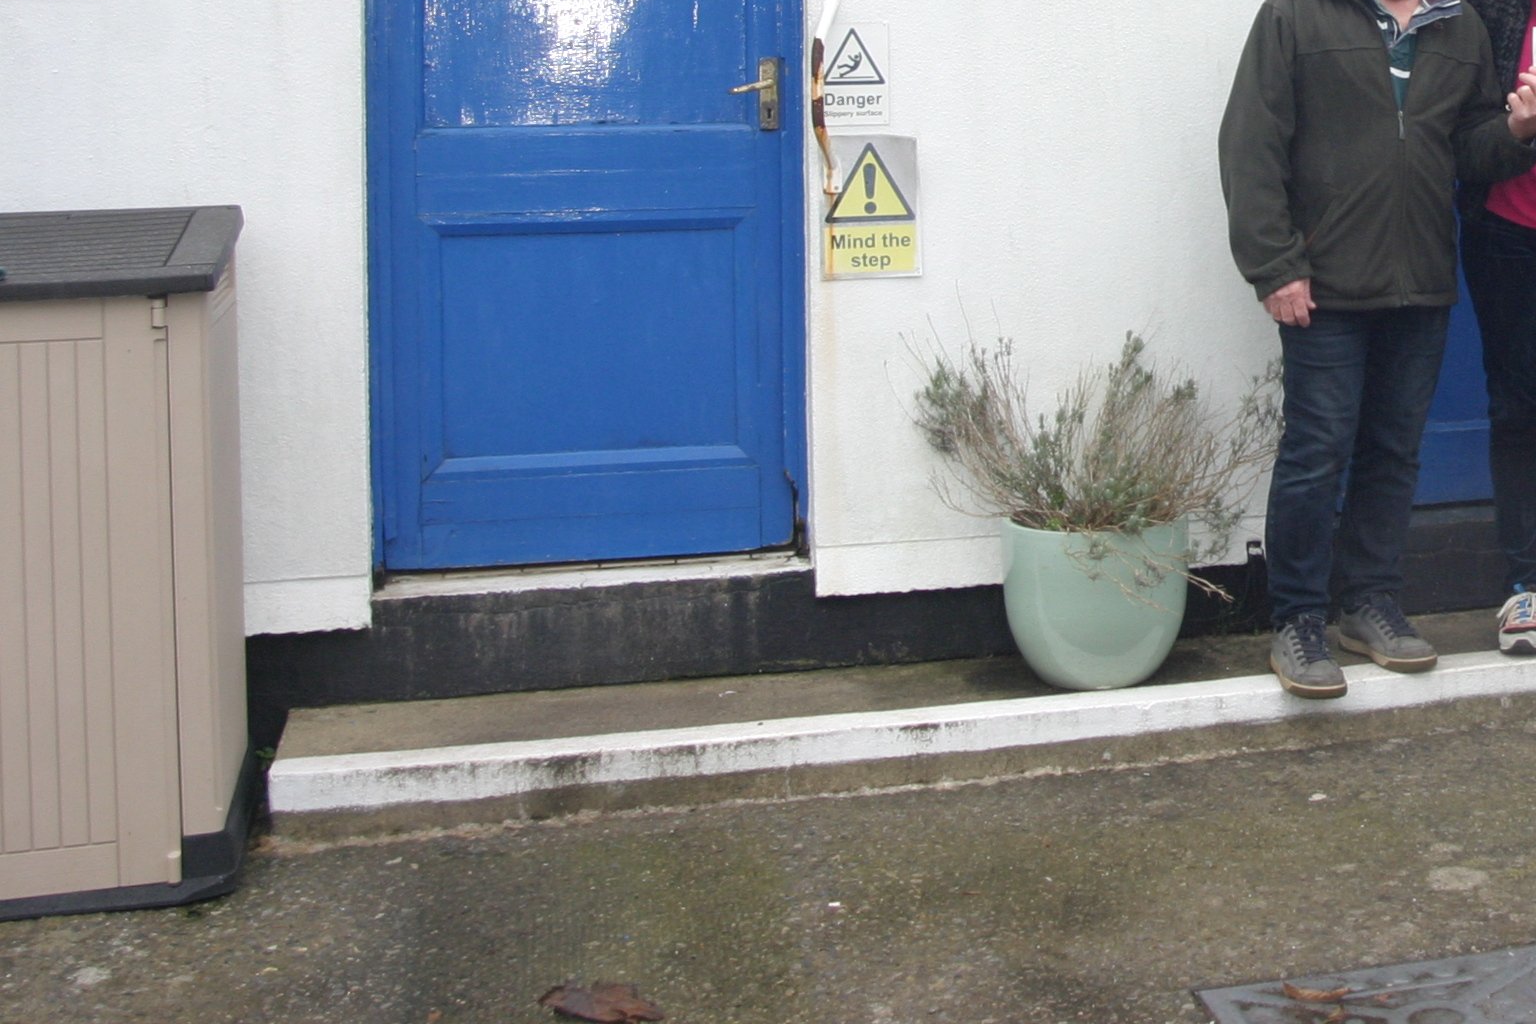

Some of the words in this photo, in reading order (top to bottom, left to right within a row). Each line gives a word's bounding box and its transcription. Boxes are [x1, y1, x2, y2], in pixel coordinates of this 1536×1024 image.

[824, 93, 883, 109] Danger
[831, 234, 876, 250] Mind
[882, 233, 911, 248] the
[851, 253, 891, 270] step
